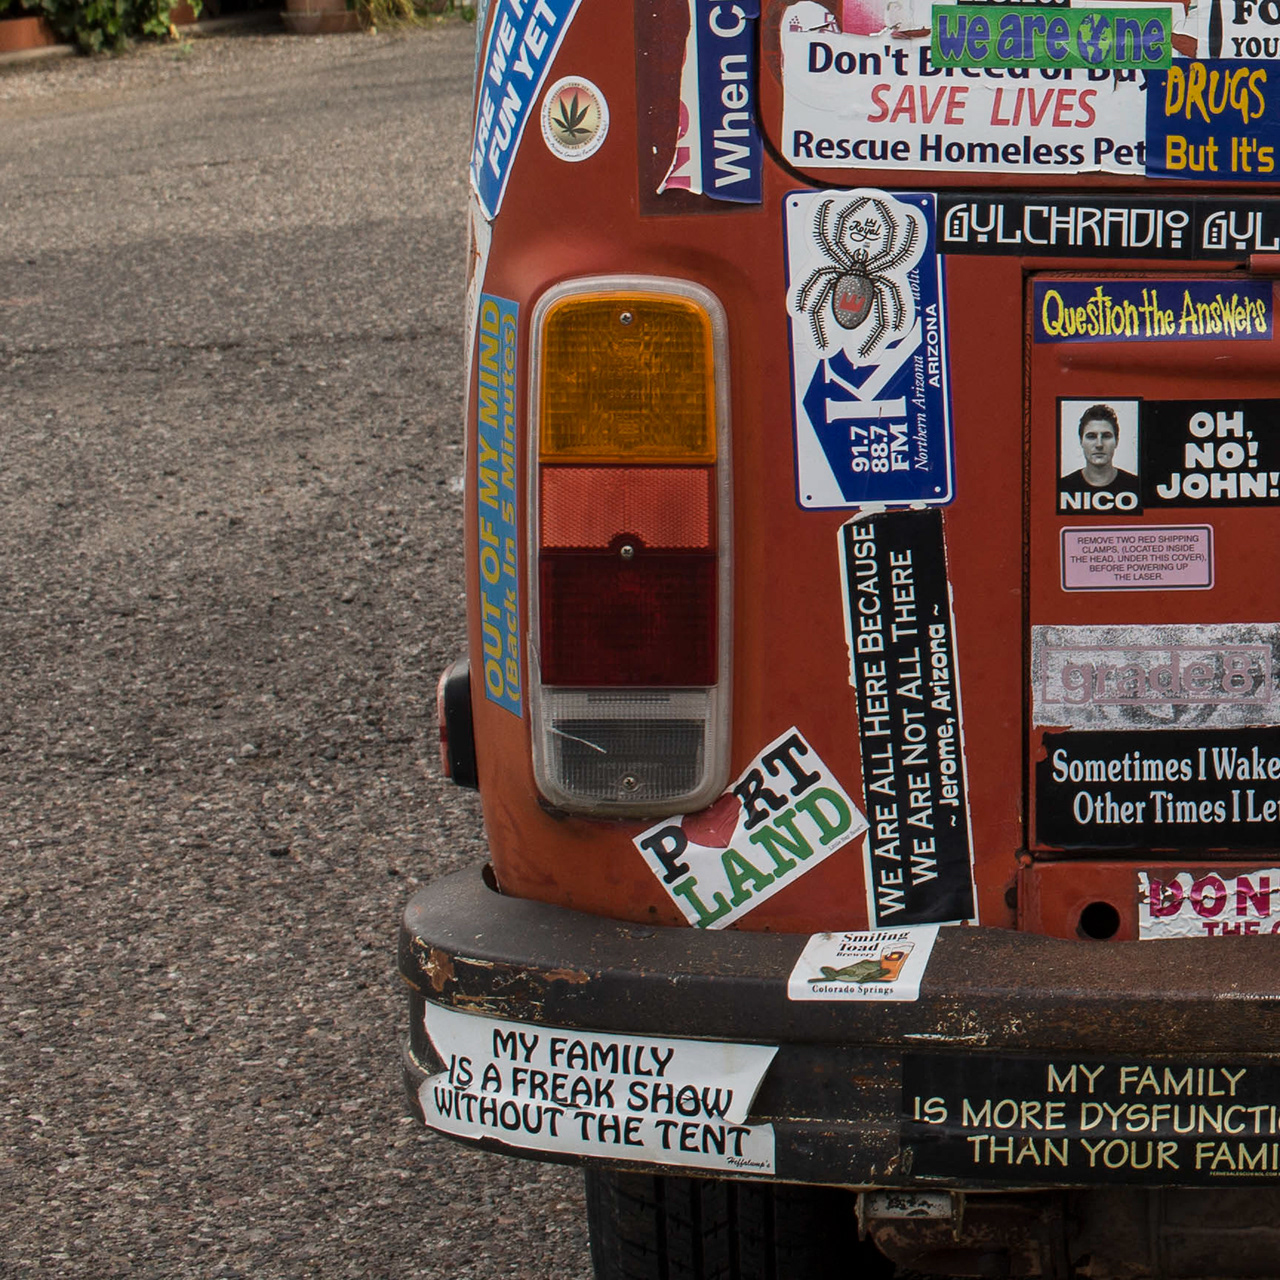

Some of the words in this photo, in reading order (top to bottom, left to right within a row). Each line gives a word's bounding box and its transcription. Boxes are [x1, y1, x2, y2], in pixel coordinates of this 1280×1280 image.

[1189, 411, 1253, 441] OH,
[1184, 441, 1259, 469] NO!
[1156, 471, 1280, 499] JOHN!
[1060, 491, 1139, 511] NICO
[493, 1029, 540, 1063] MY
[550, 1037, 674, 1078] FAMILY
[449, 1054, 473, 1089] IS
[481, 1061, 502, 1093] A
[512, 1065, 616, 1110] FREAK
[629, 1080, 733, 1121] SHOW
[433, 1086, 565, 1138] WITHOUT
[574, 1111, 645, 1148] THE
[655, 1119, 751, 1158] TENT
